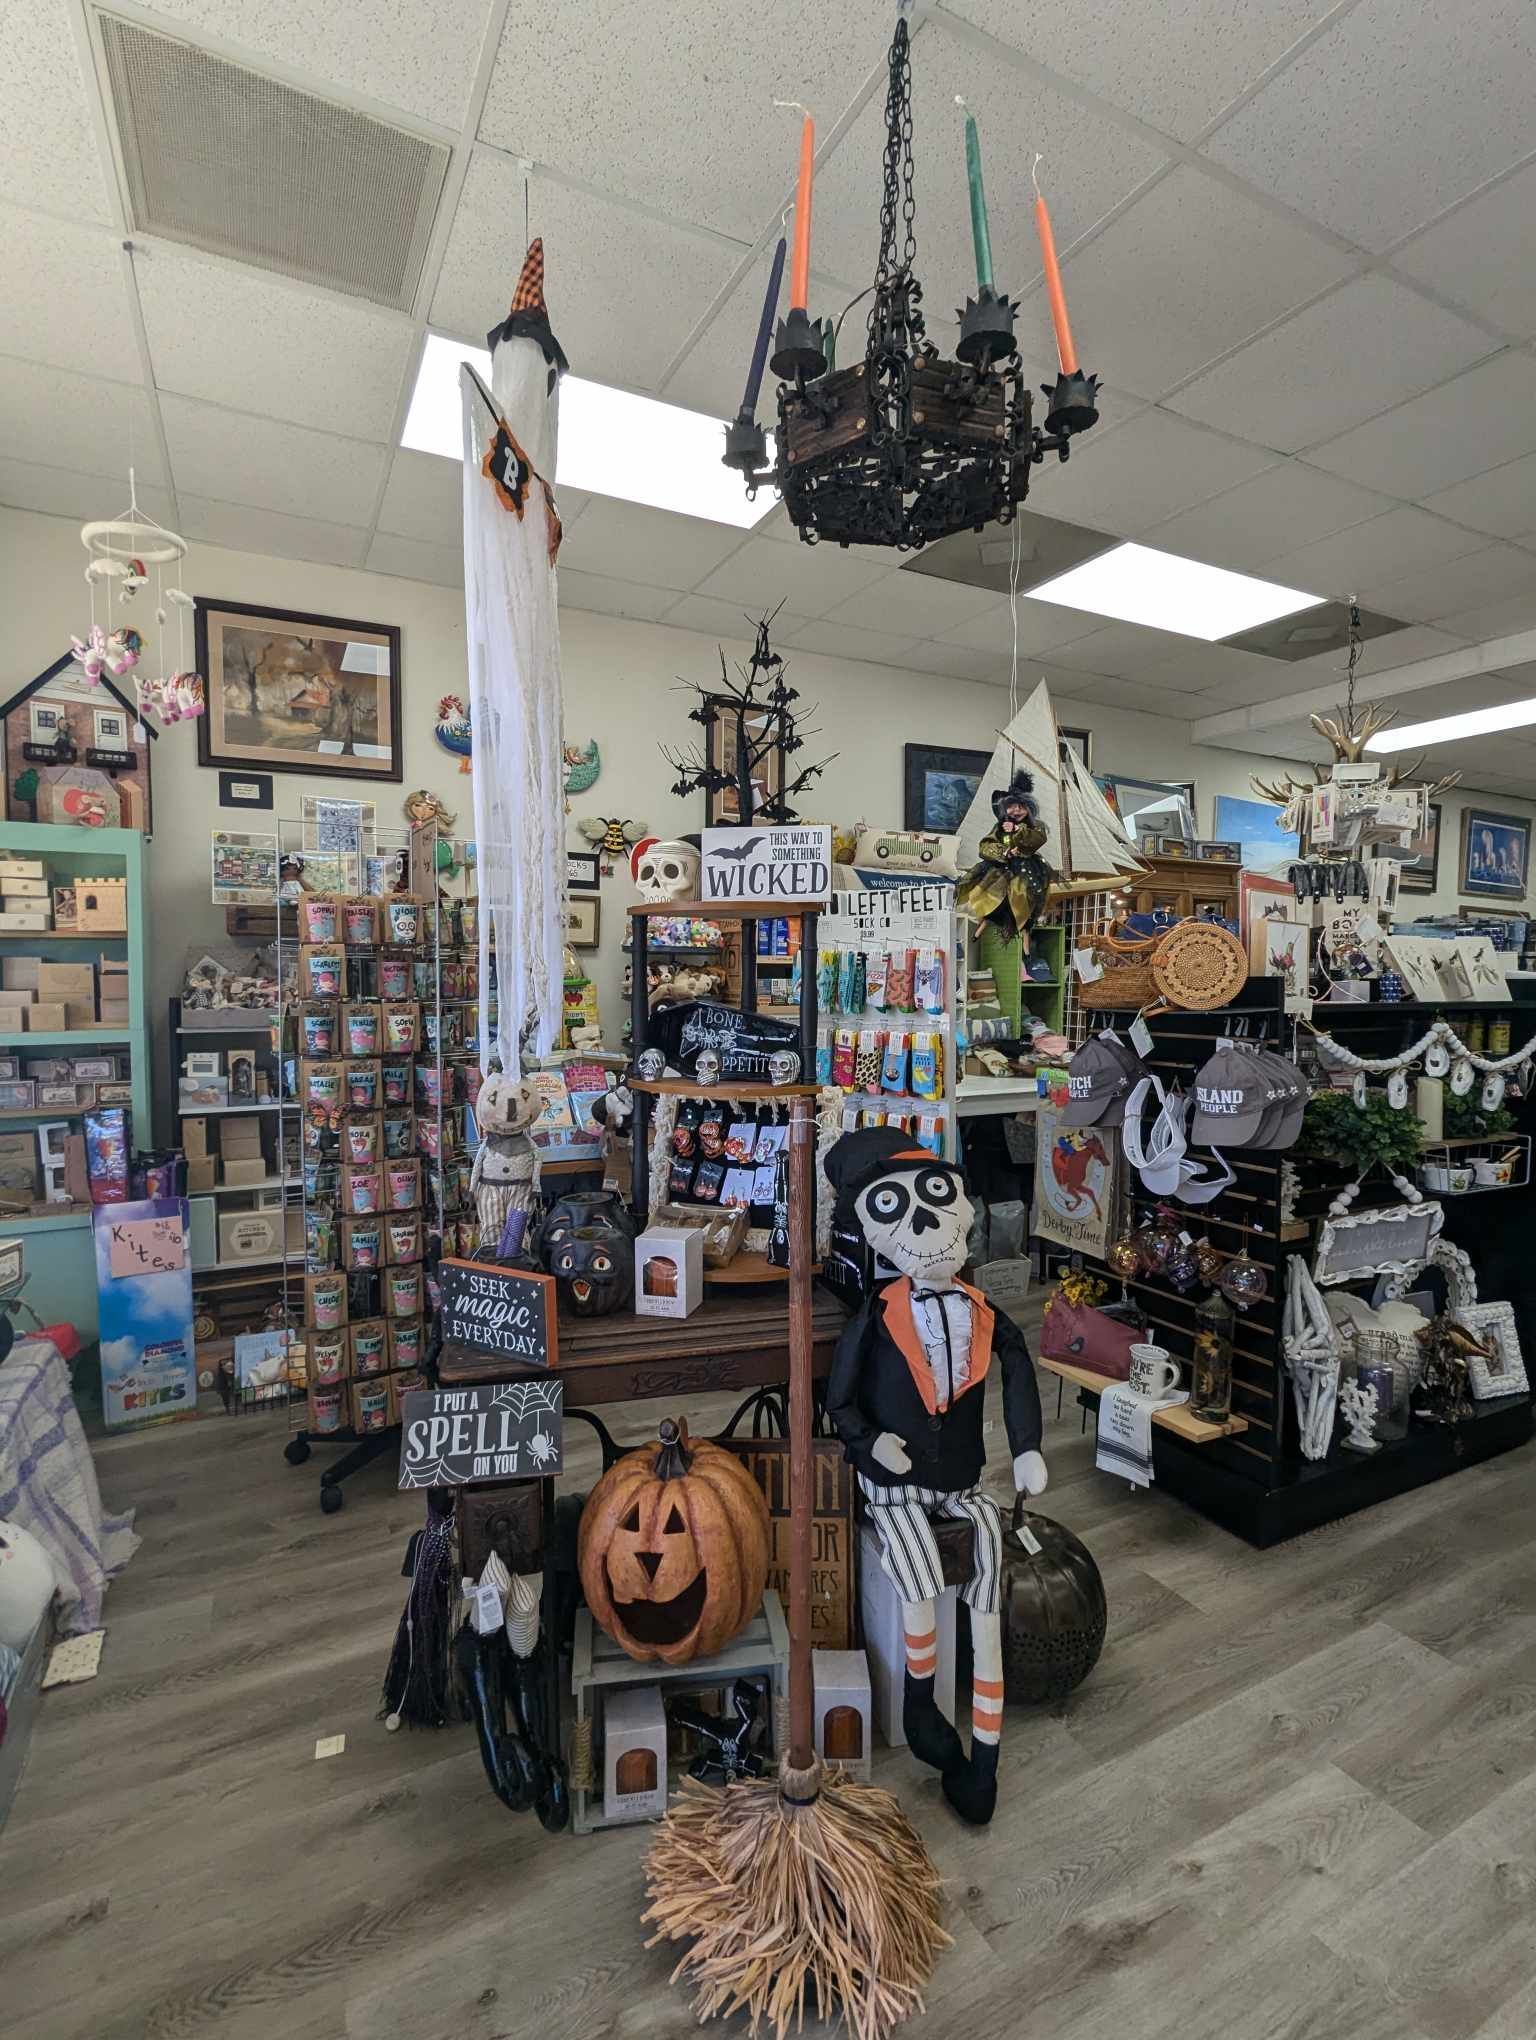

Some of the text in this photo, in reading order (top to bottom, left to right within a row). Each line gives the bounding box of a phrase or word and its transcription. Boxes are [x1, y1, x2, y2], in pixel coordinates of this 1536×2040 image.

[502, 446, 519, 491] B
[770, 831, 823, 845] THIS WAY TO
[772, 847, 821, 861] SOMETHING
[707, 861, 829, 897] WICKED
[848, 891, 891, 916] LEFT
[1343, 908, 1360, 917] MY
[853, 917, 890, 929] SOCK CO
[706, 1007, 744, 1030] BONE
[721, 1056, 769, 1073] PPETIT
[1196, 1087, 1244, 1105] ISLAND
[1200, 1101, 1239, 1114] PEOPLE
[1042, 1211, 1101, 1245] Derby Time
[469, 1275, 511, 1300] SEEK
[454, 1293, 530, 1330] magic
[452, 1319, 537, 1355] EVERYDAY
[433, 1392, 479, 1414] I PUT A
[405, 1410, 520, 1463] SPELL
[473, 1453, 518, 1477] ON YOU
